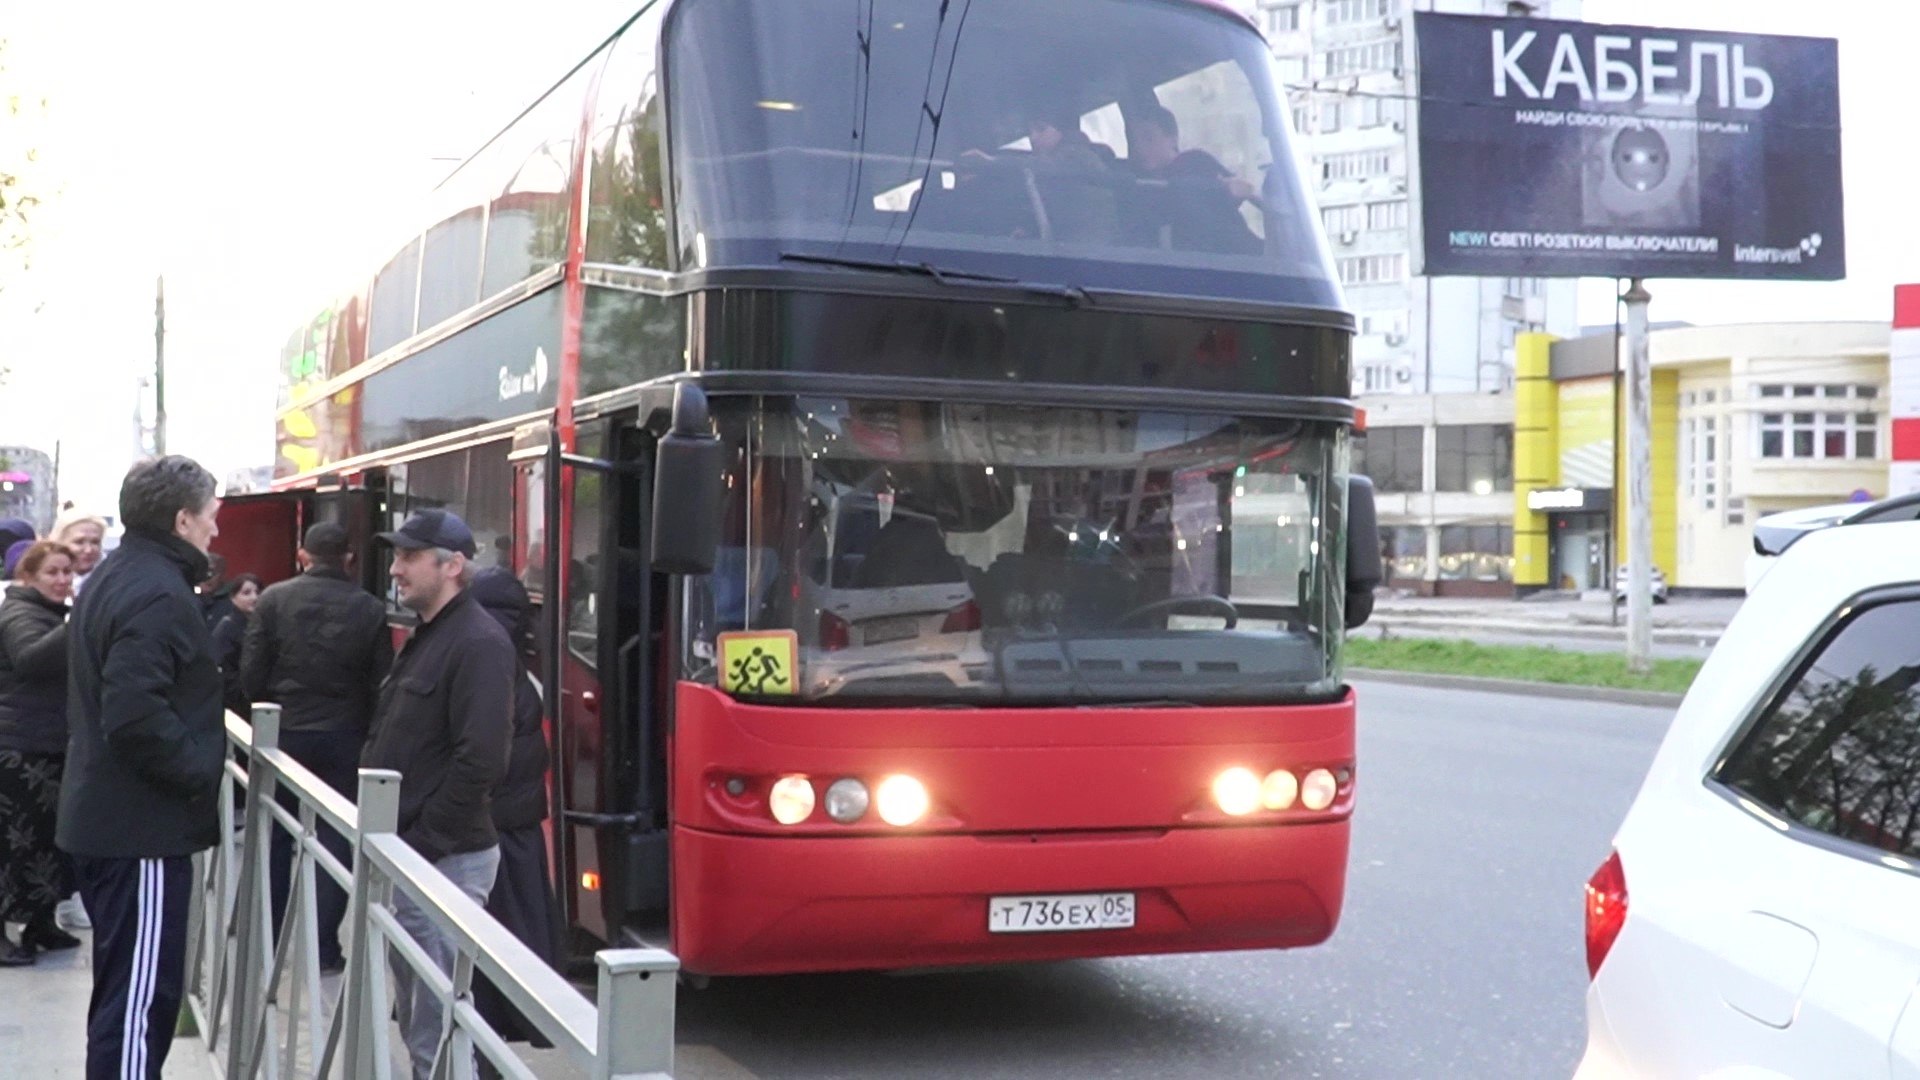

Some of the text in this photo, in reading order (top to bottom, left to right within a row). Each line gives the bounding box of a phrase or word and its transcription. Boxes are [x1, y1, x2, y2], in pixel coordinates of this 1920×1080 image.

[1491, 29, 1774, 110] КАБЕЛЬ
[1515, 110, 1565, 127] НАЙДИ
[1566, 111, 1608, 128] СВОЮ
